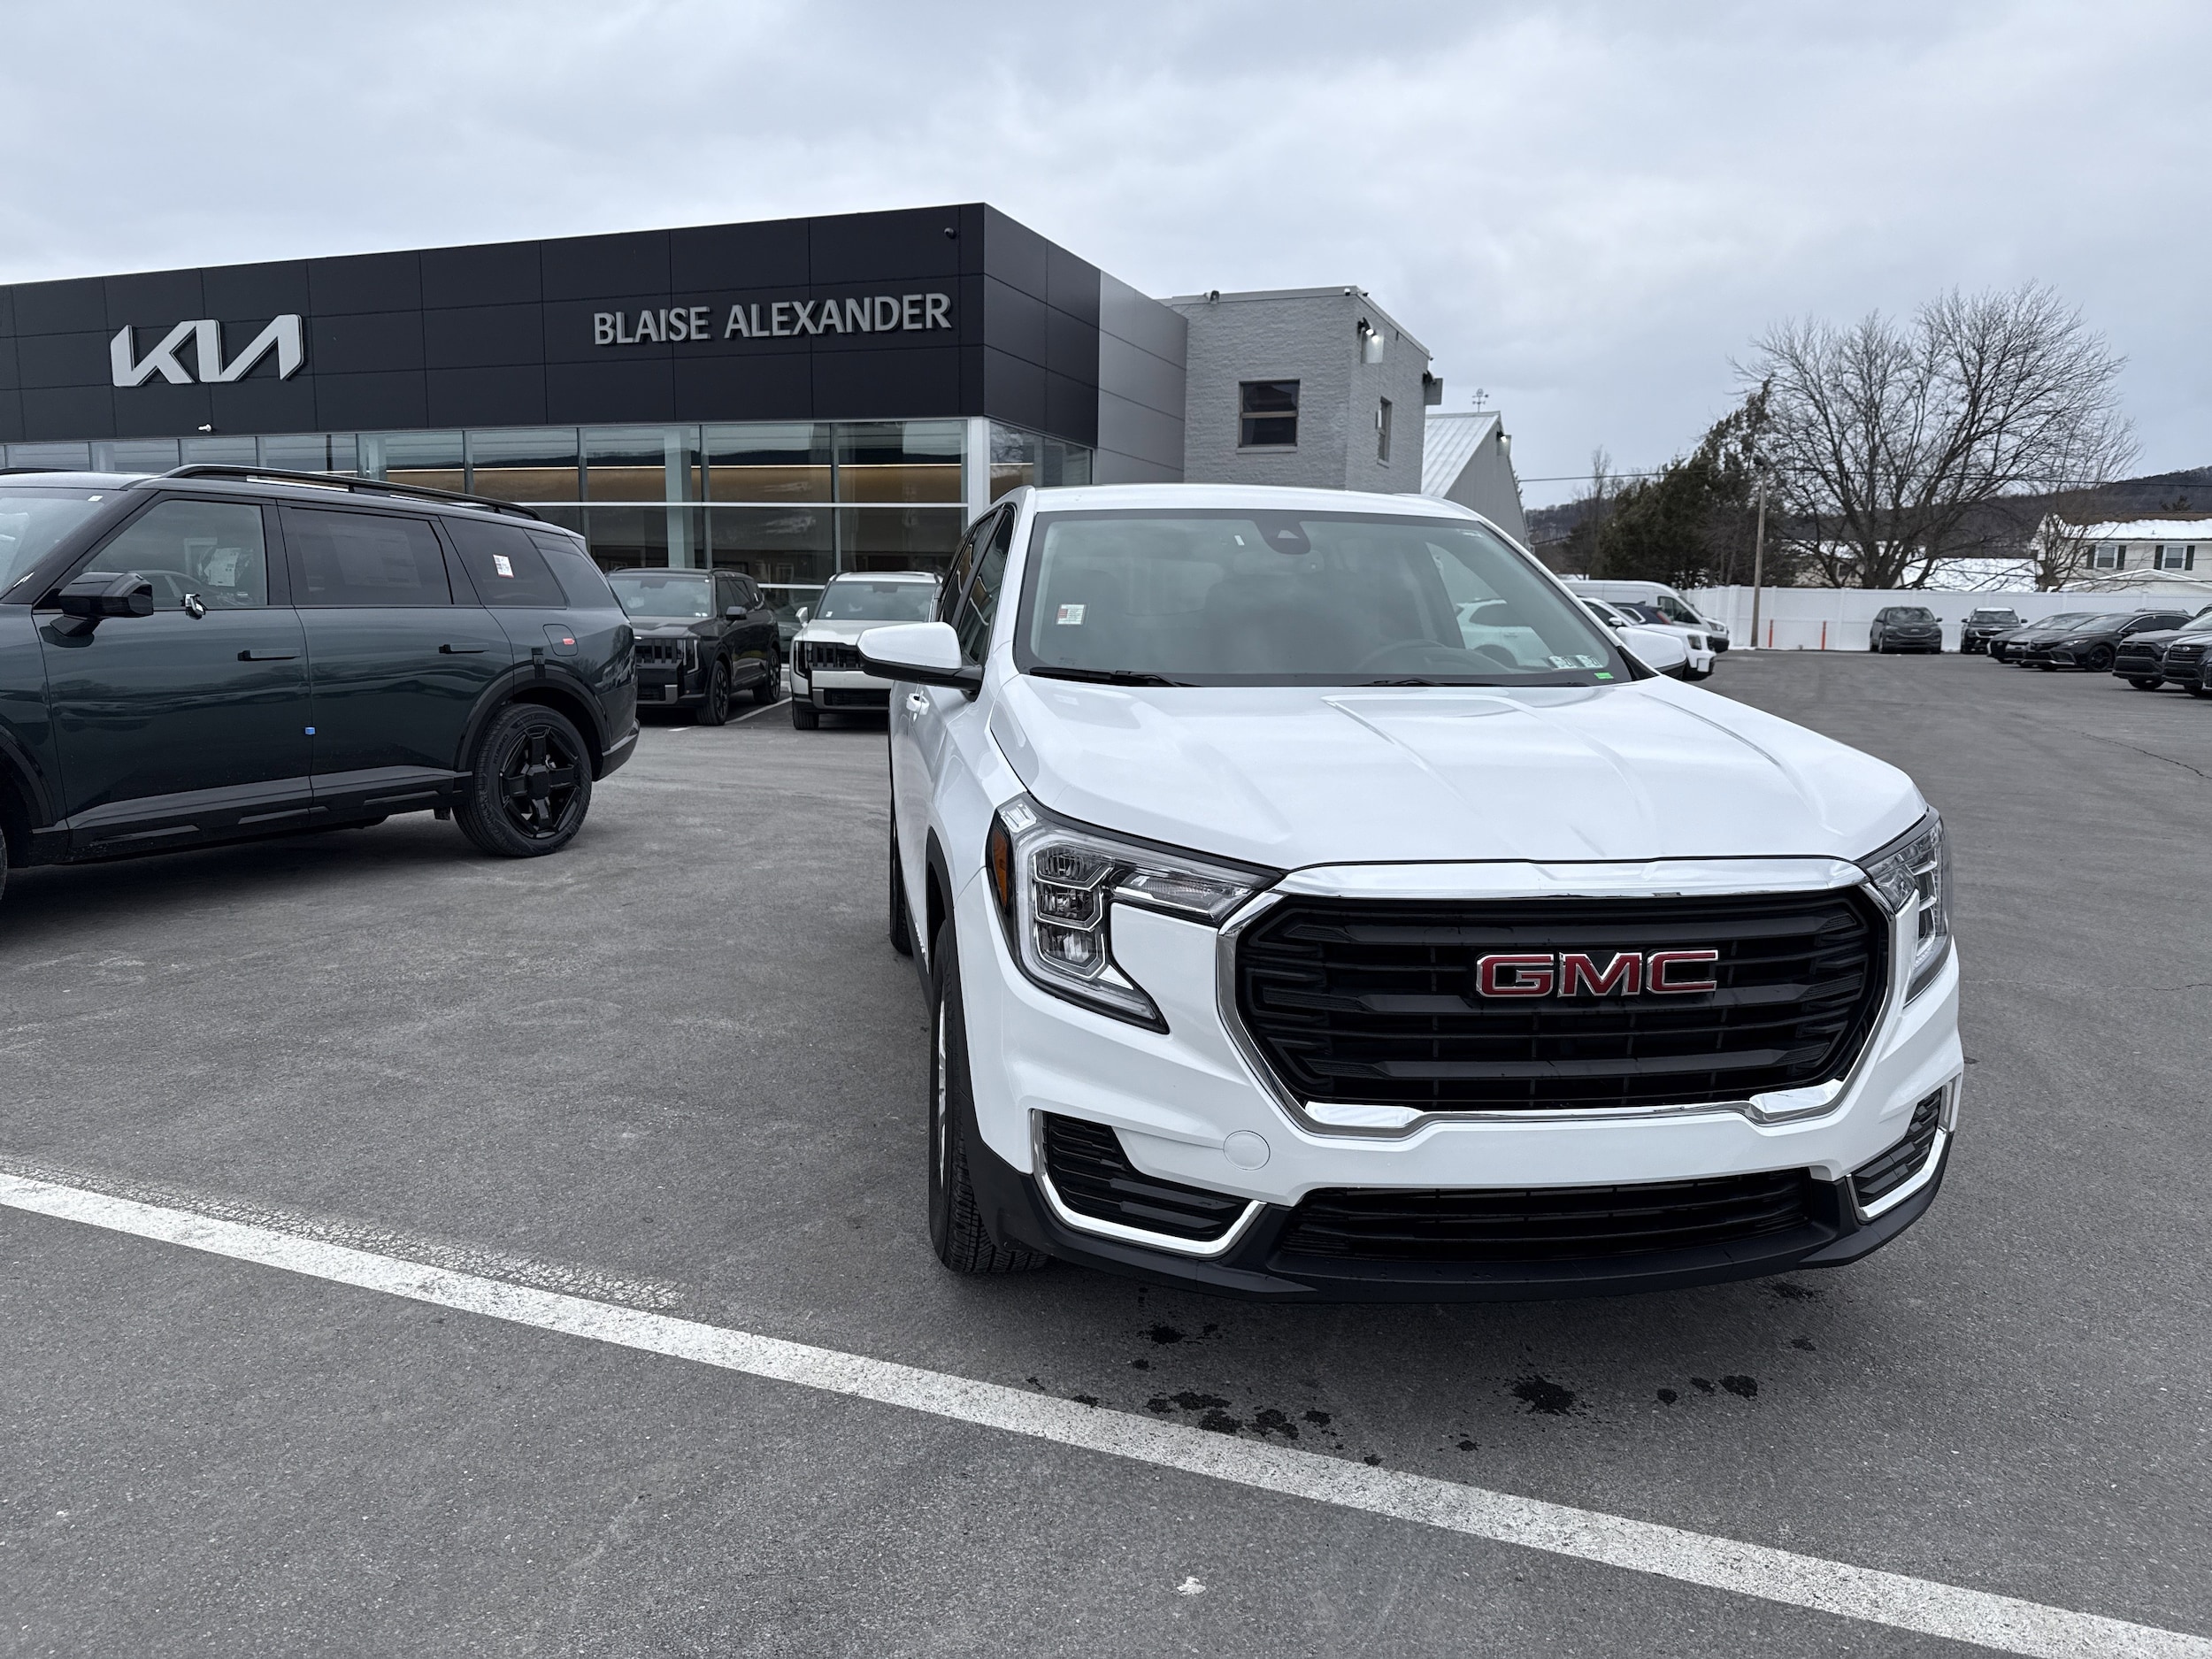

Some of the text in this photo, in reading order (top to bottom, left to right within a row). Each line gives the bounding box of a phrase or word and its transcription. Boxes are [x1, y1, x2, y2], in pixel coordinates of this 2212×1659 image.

[594, 293, 952, 345] BLAISE ALEXANDER
[111, 314, 303, 387] KIA
[494, 733, 509, 764] KUMHO
[1476, 949, 1719, 998] GMC
